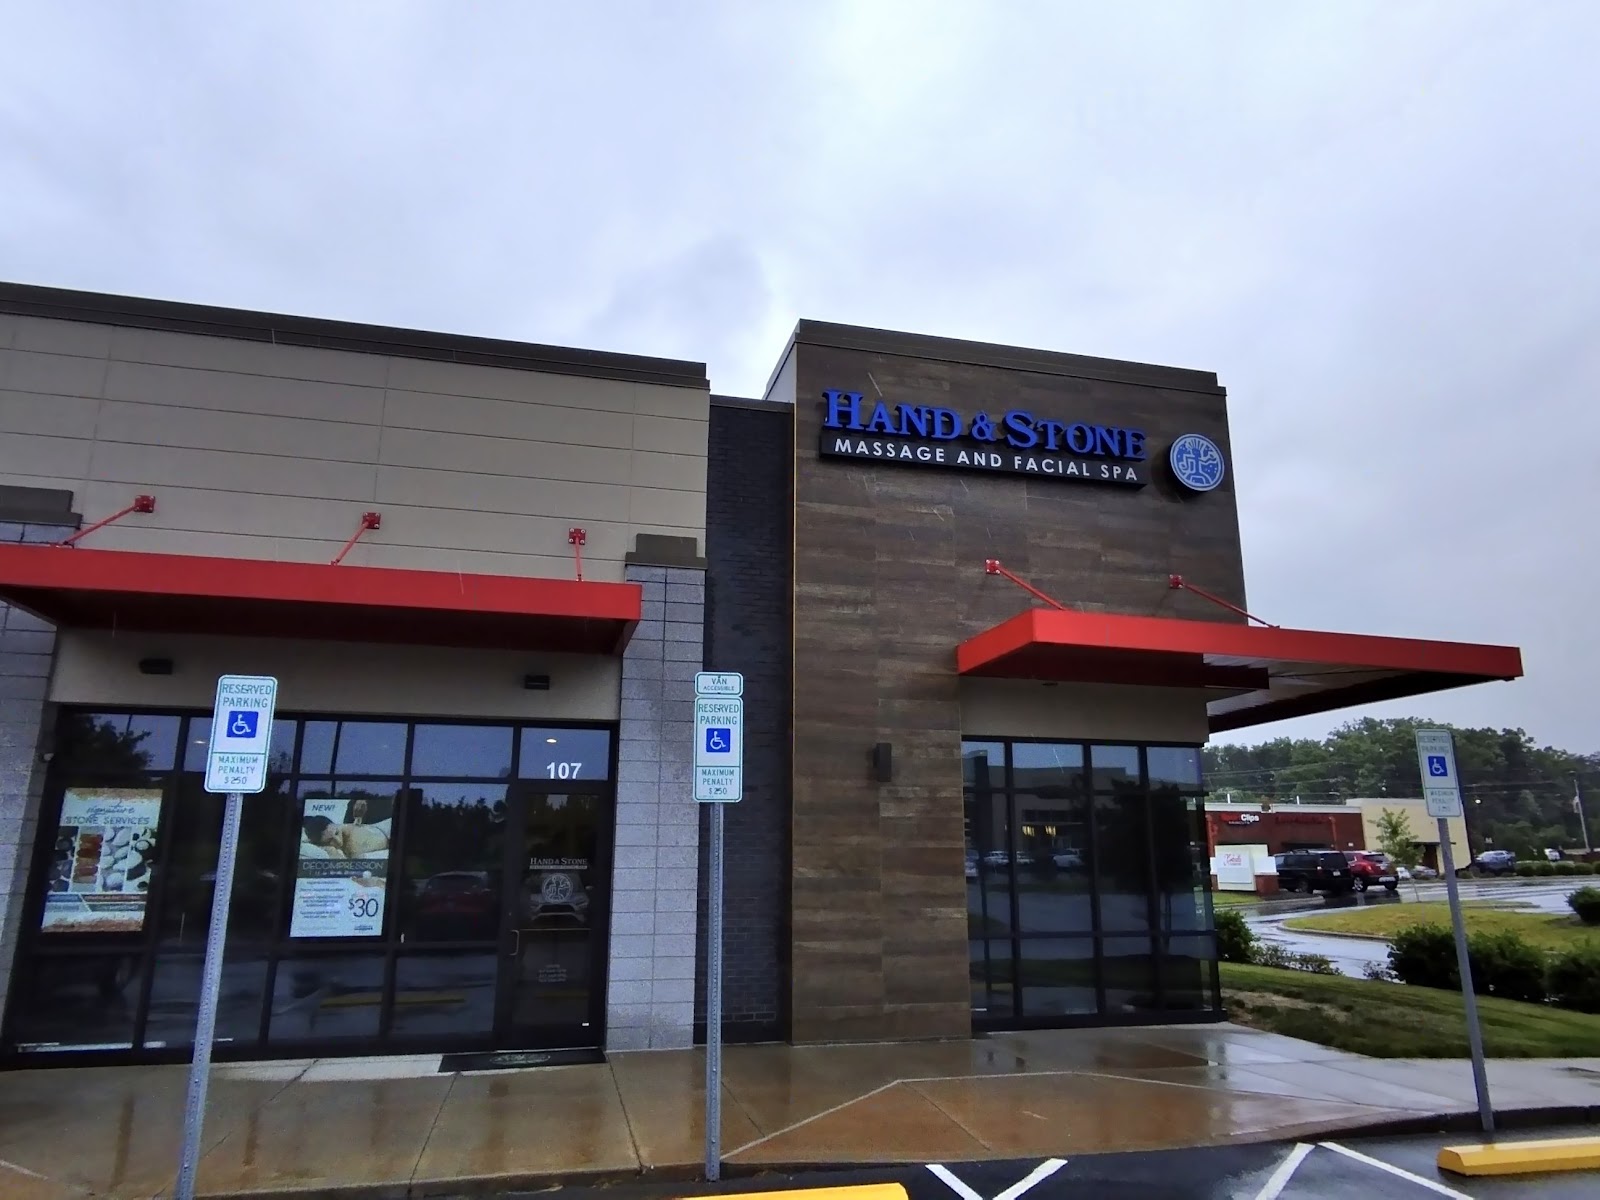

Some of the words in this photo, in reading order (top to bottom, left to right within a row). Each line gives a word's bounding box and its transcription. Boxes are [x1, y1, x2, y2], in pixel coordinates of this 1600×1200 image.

[822, 389, 963, 439] HAND
[970, 410, 997, 441] &
[1003, 409, 1147, 462] STONE
[834, 438, 945, 462] MASSAGE
[957, 450, 1002, 467] AND
[1014, 456, 1090, 476] FACIAL
[1101, 464, 1138, 481] SPA
[220, 683, 272, 695] RESERVED
[222, 696, 269, 708] PARKING
[698, 703, 740, 713] RESERVED
[700, 715, 738, 725] PARKING
[218, 755, 259, 764] MAXIMUM
[217, 765, 256, 775] PENALTY
[546, 762, 582, 779] 107
[701, 768, 735, 777] MAXIMUM
[224, 776, 248, 785] $250
[702, 778, 734, 786] PENALTY
[708, 787, 728, 795] $250
[311, 804, 336, 812] NEW!
[65, 815, 99, 825] STONE
[103, 815, 150, 825] SERVICES
[1240, 813, 1260, 823] Clips
[302, 861, 384, 871] DECOMPRESSION
[530, 857, 554, 865] HAND
[560, 857, 588, 865] STONE
[348, 898, 379, 918] $30
